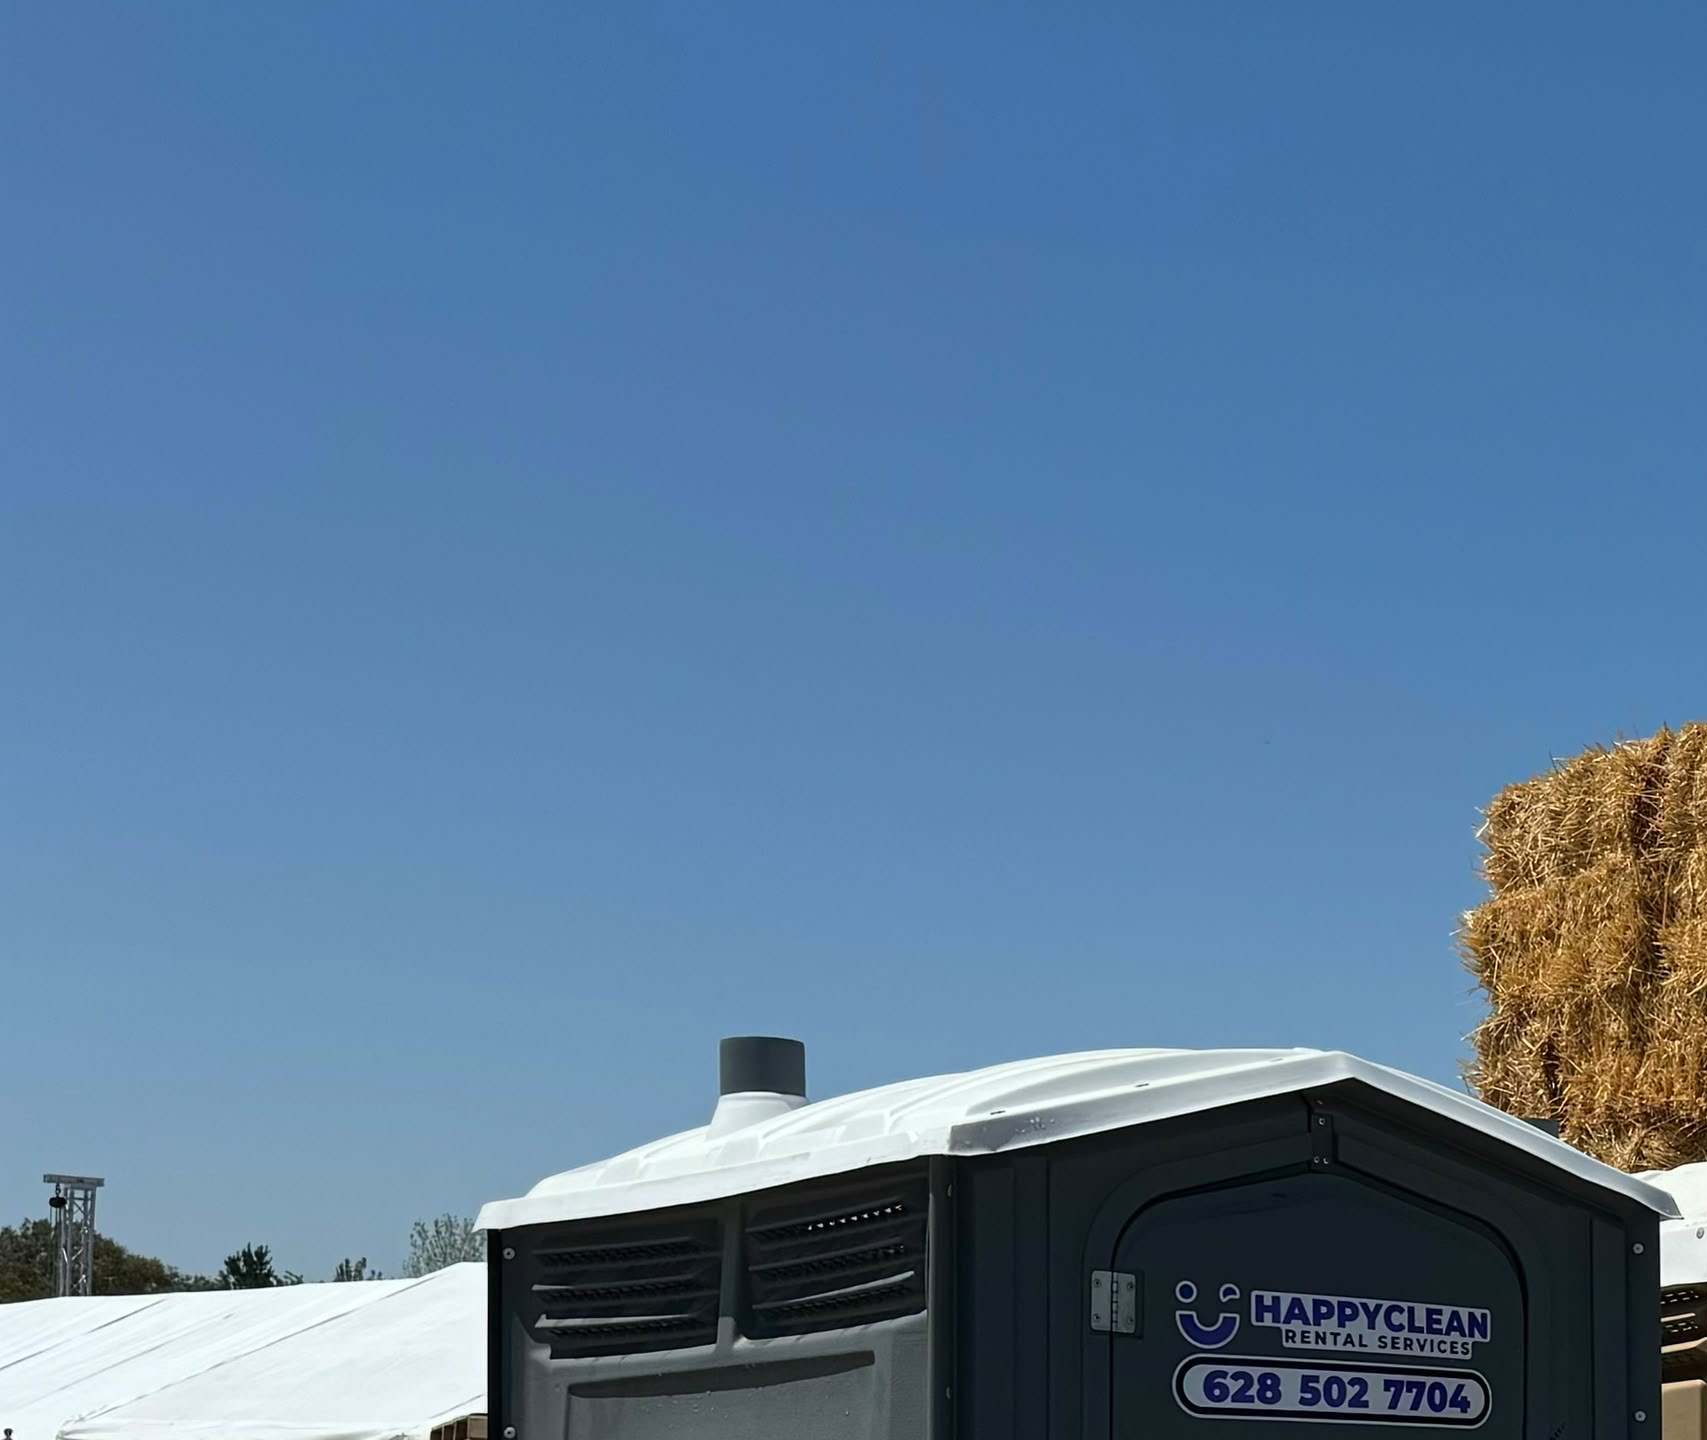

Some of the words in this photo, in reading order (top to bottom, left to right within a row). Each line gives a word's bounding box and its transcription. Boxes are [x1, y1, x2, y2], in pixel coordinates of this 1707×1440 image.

[1254, 1294, 1488, 1340] HAPPYCLEAN
[1284, 1328, 1368, 1348] RENTAL
[1378, 1335, 1471, 1356] SERVICES
[1202, 1369, 1282, 1404] 628
[1298, 1374, 1370, 1409] 502
[1383, 1379, 1471, 1414] 7704
